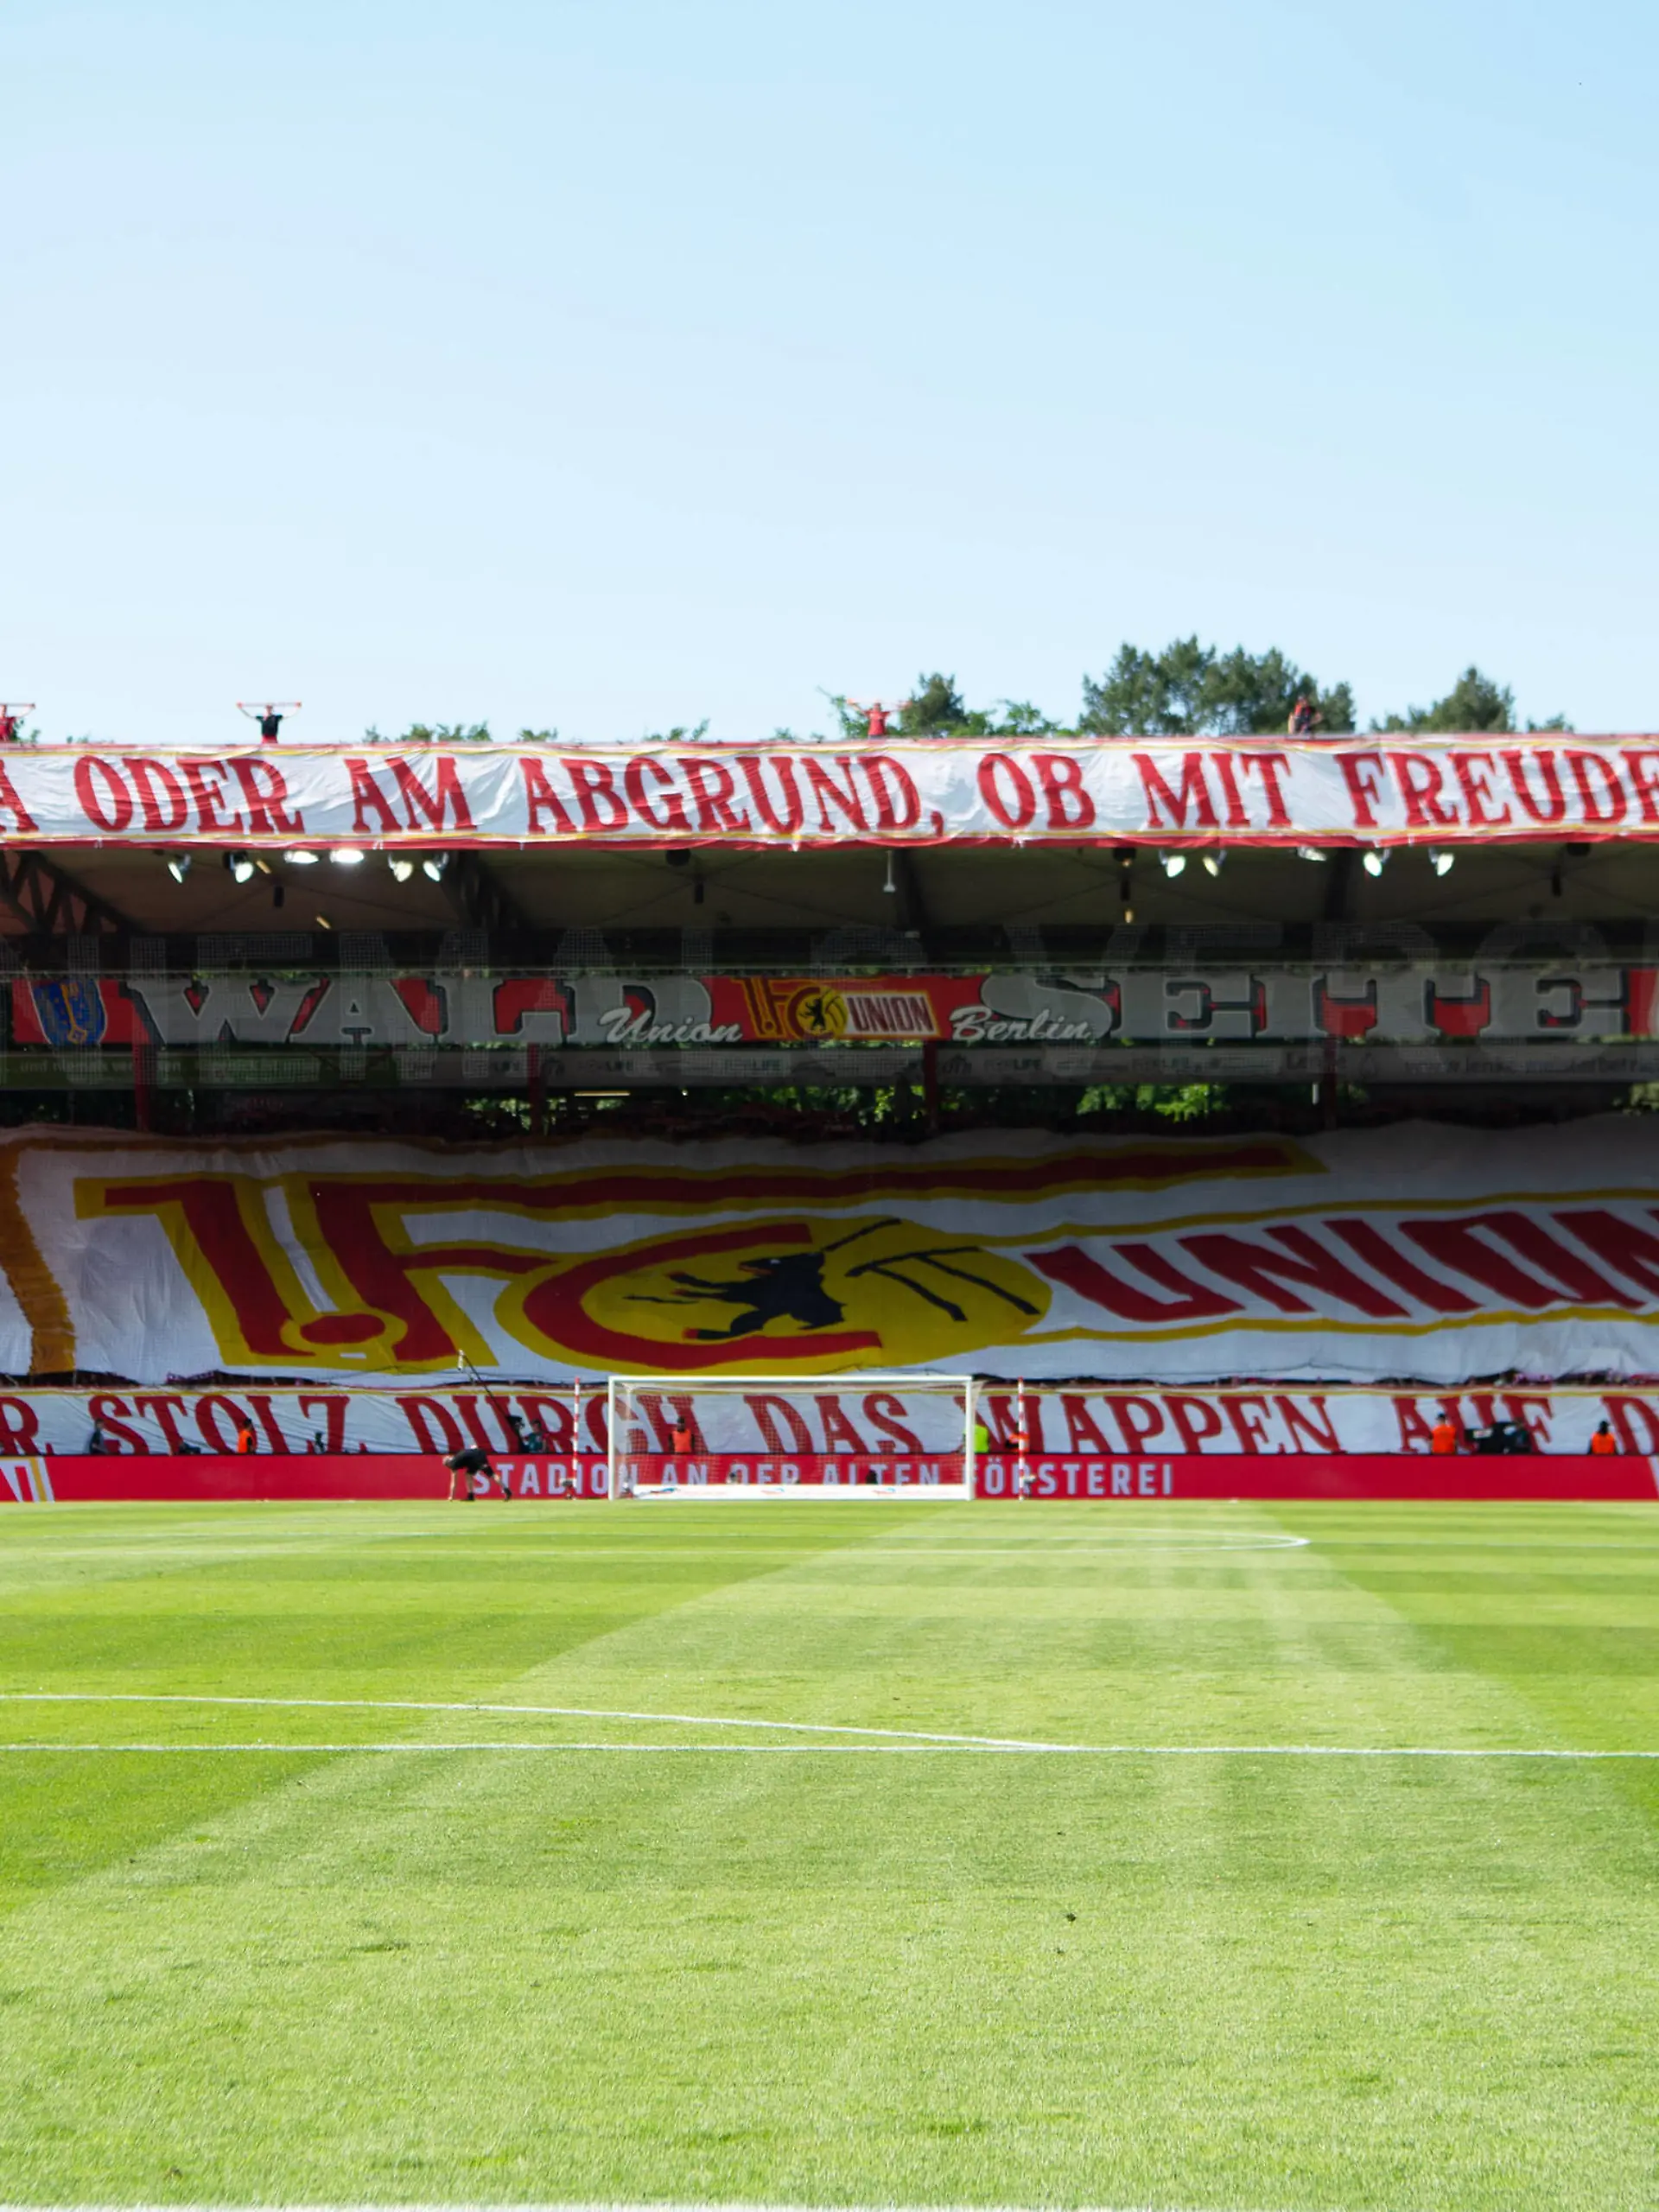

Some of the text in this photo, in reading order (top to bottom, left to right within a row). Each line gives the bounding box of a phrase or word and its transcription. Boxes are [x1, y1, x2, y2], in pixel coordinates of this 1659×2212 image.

[73, 754, 305, 834] ODER
[343, 756, 478, 834] AM
[518, 754, 944, 836] ABGRUND,
[976, 753, 1096, 830] OB
[1129, 751, 1293, 830] MIT
[600, 1004, 1092, 1043] Union Berlin
[846, 995, 936, 1033] UNION
[744, 1394, 925, 1454] DAS
[953, 1393, 1349, 1454] WAPPEN
